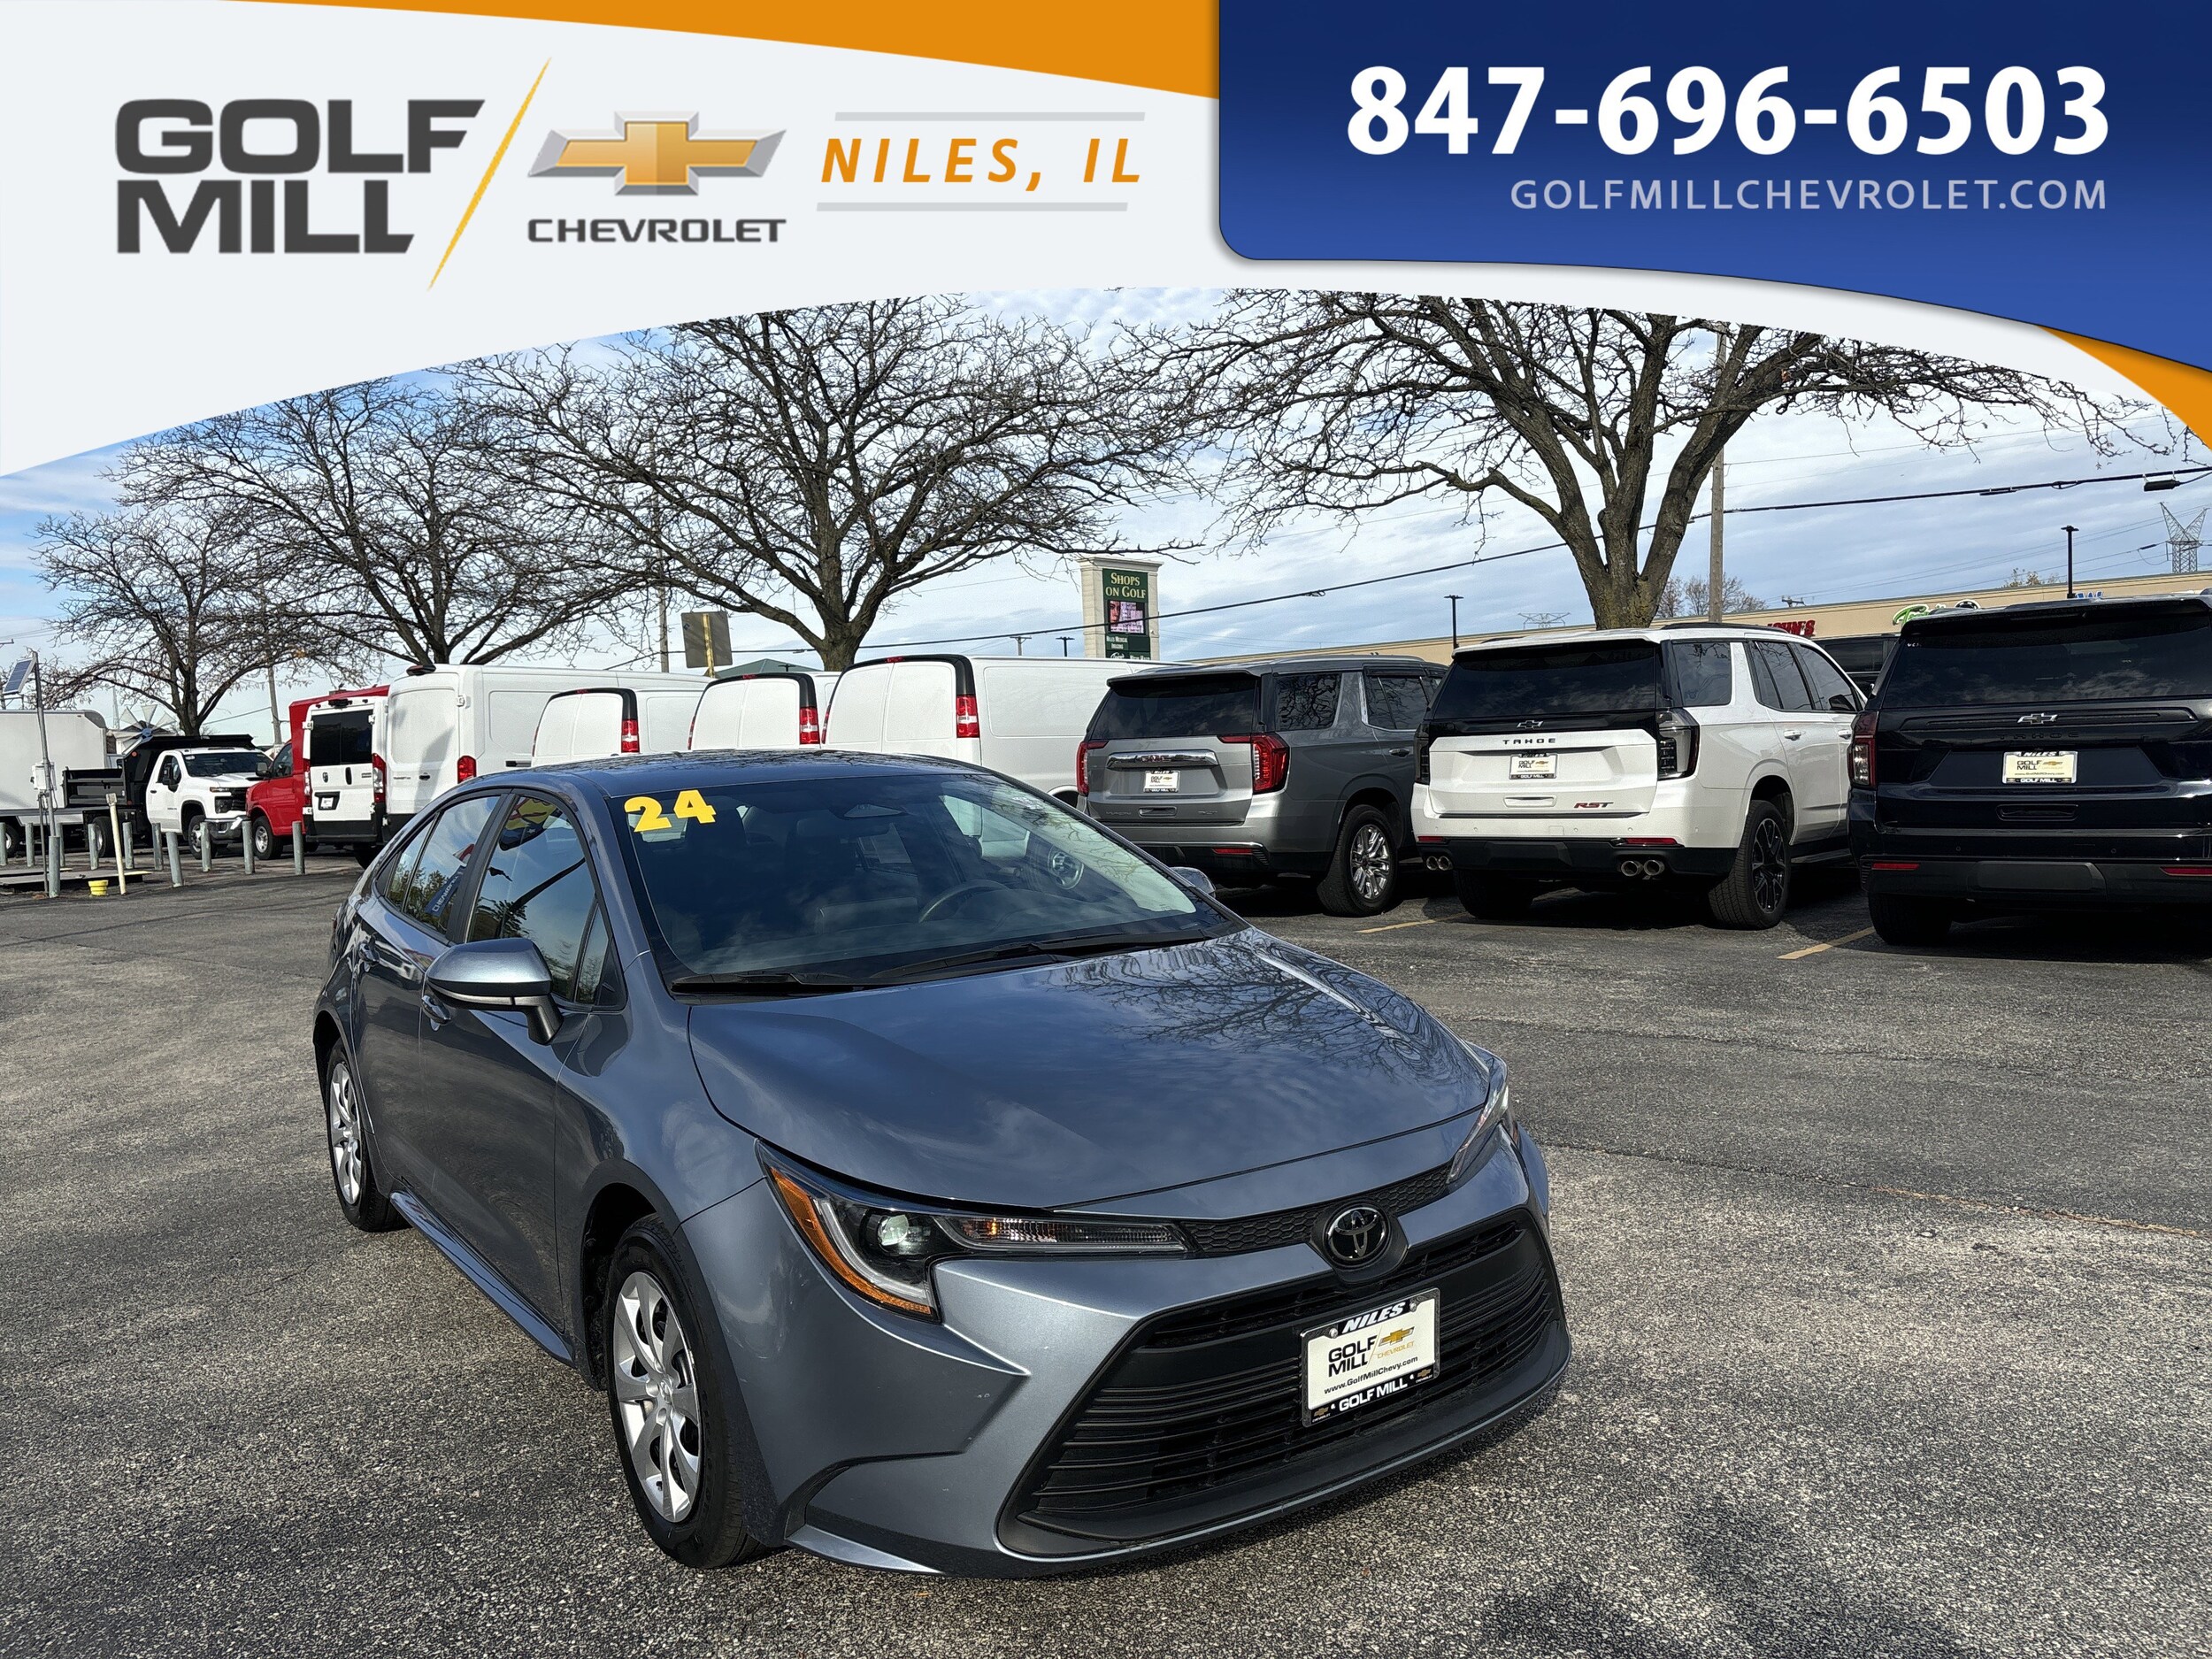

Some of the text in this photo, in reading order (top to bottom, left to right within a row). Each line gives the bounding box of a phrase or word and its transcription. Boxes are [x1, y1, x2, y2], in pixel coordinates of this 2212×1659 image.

[1998, 732, 2079, 741] TAHOE
[625, 790, 716, 833] 24
[1342, 1302, 1406, 1334] NILES
[1329, 1335, 1378, 1363] GOLF
[1377, 1341, 1415, 1359] CHEVROLET
[1324, 1356, 1418, 1394] www.GolfMillChevy.com
[1329, 1354, 1368, 1378] MILL
[1339, 1378, 1408, 1411] GOLF MILL
